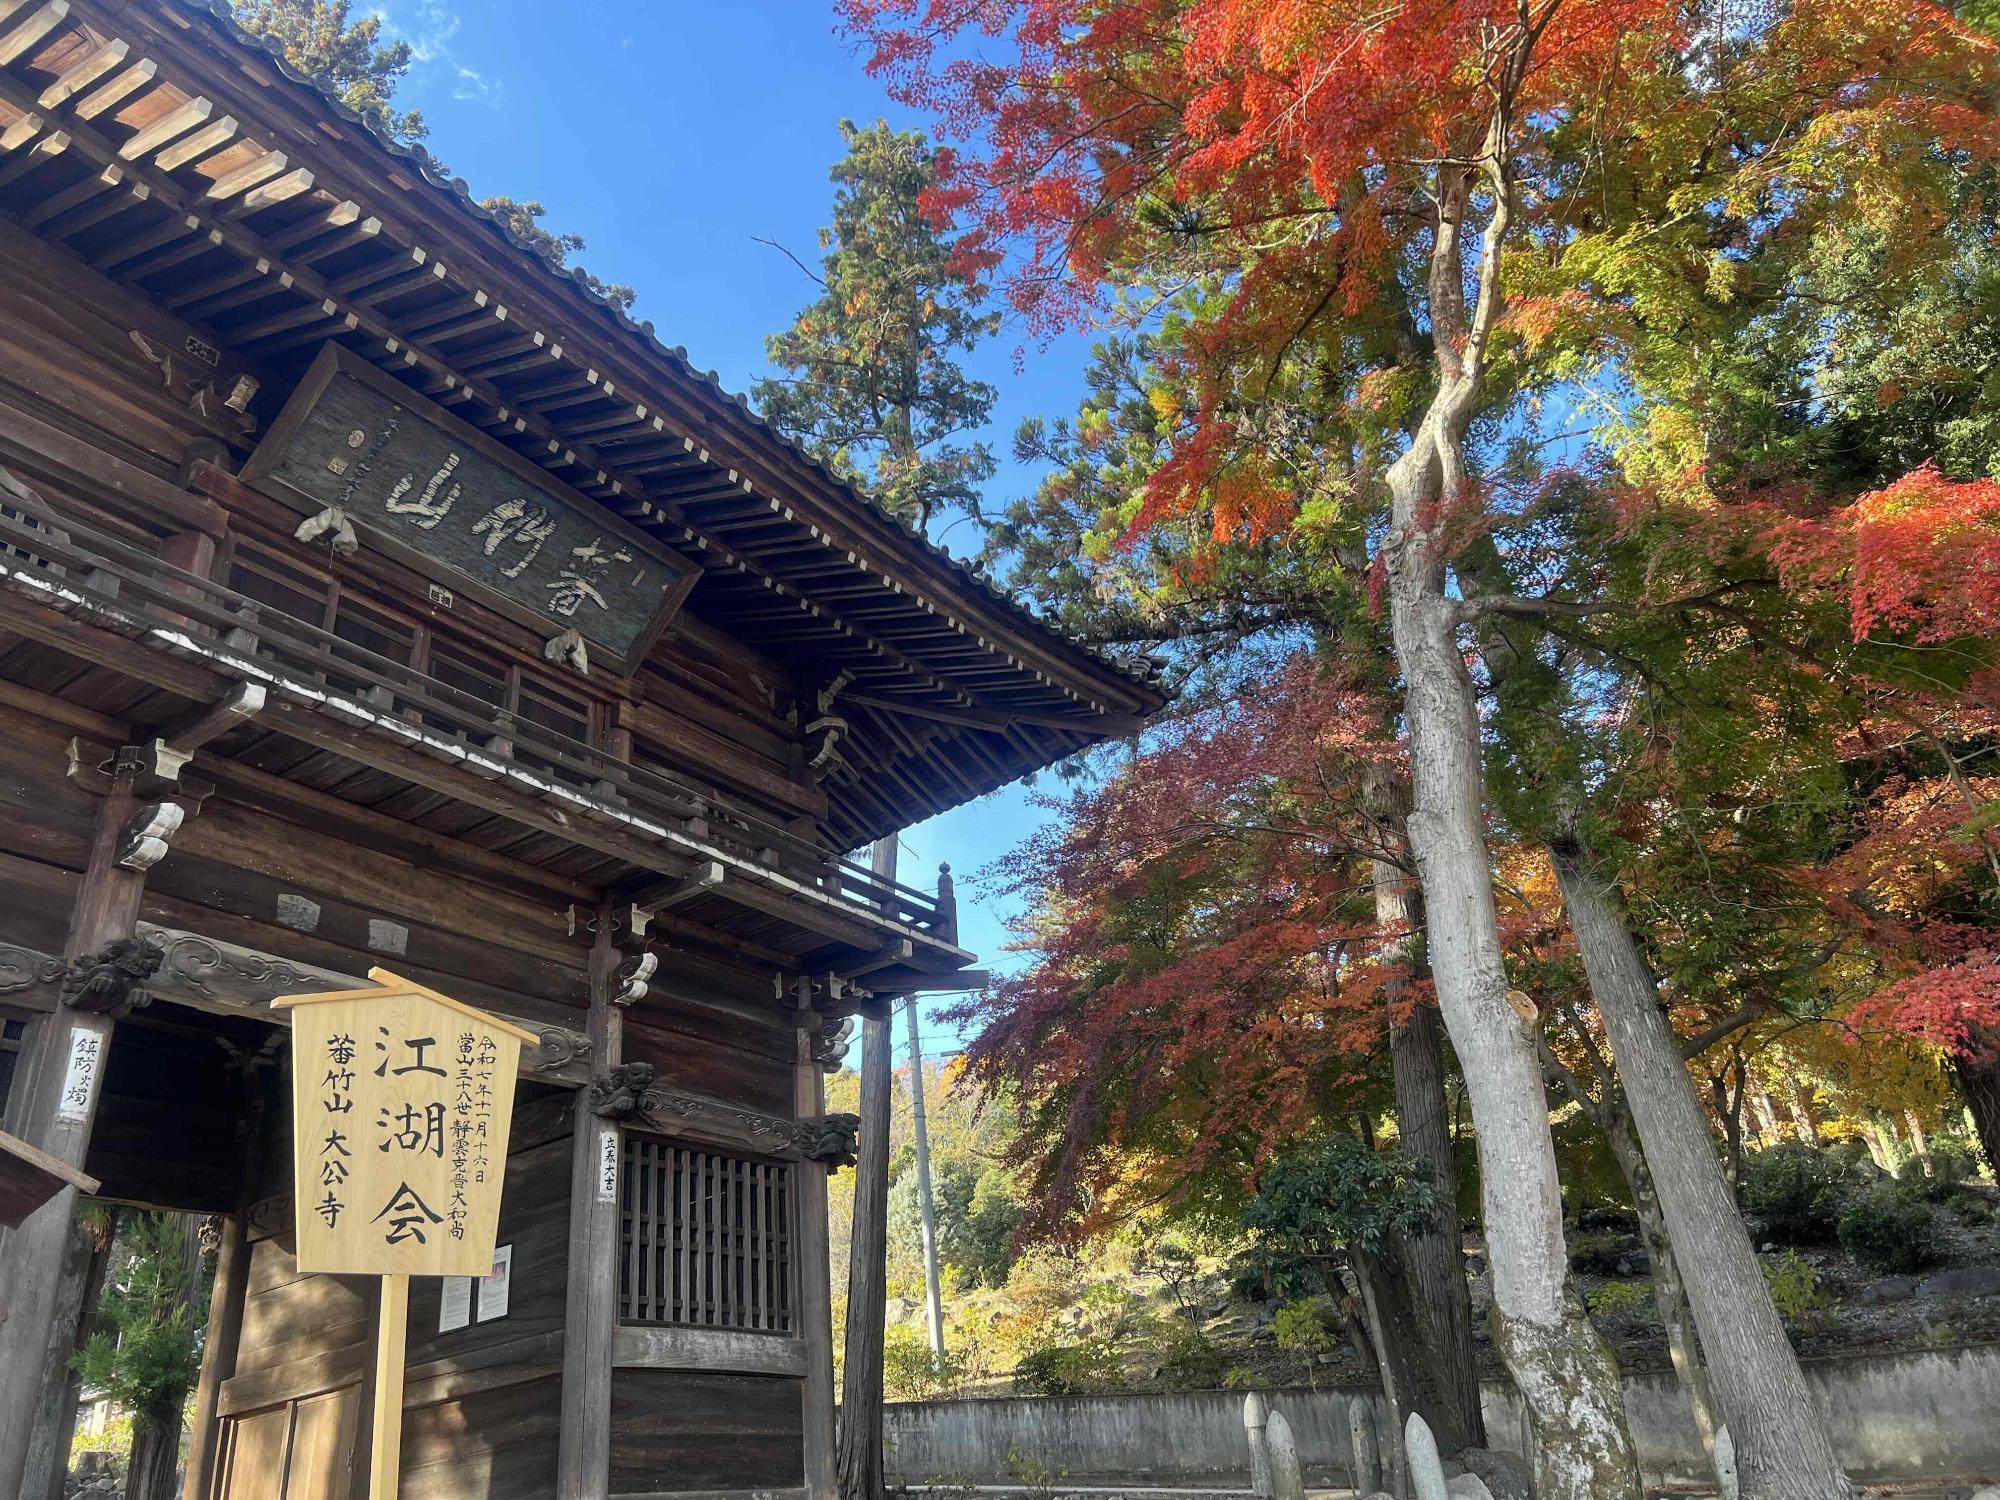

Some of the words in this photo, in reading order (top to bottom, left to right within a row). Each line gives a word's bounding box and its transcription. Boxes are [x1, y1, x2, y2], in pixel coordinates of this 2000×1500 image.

[370, 1026, 448, 1245] 江湖会
[473, 1036, 497, 1183] 令和七年十一月十六日
[604, 1136, 616, 1191] 立春大吉
[314, 1129, 353, 1229] 大公寺
